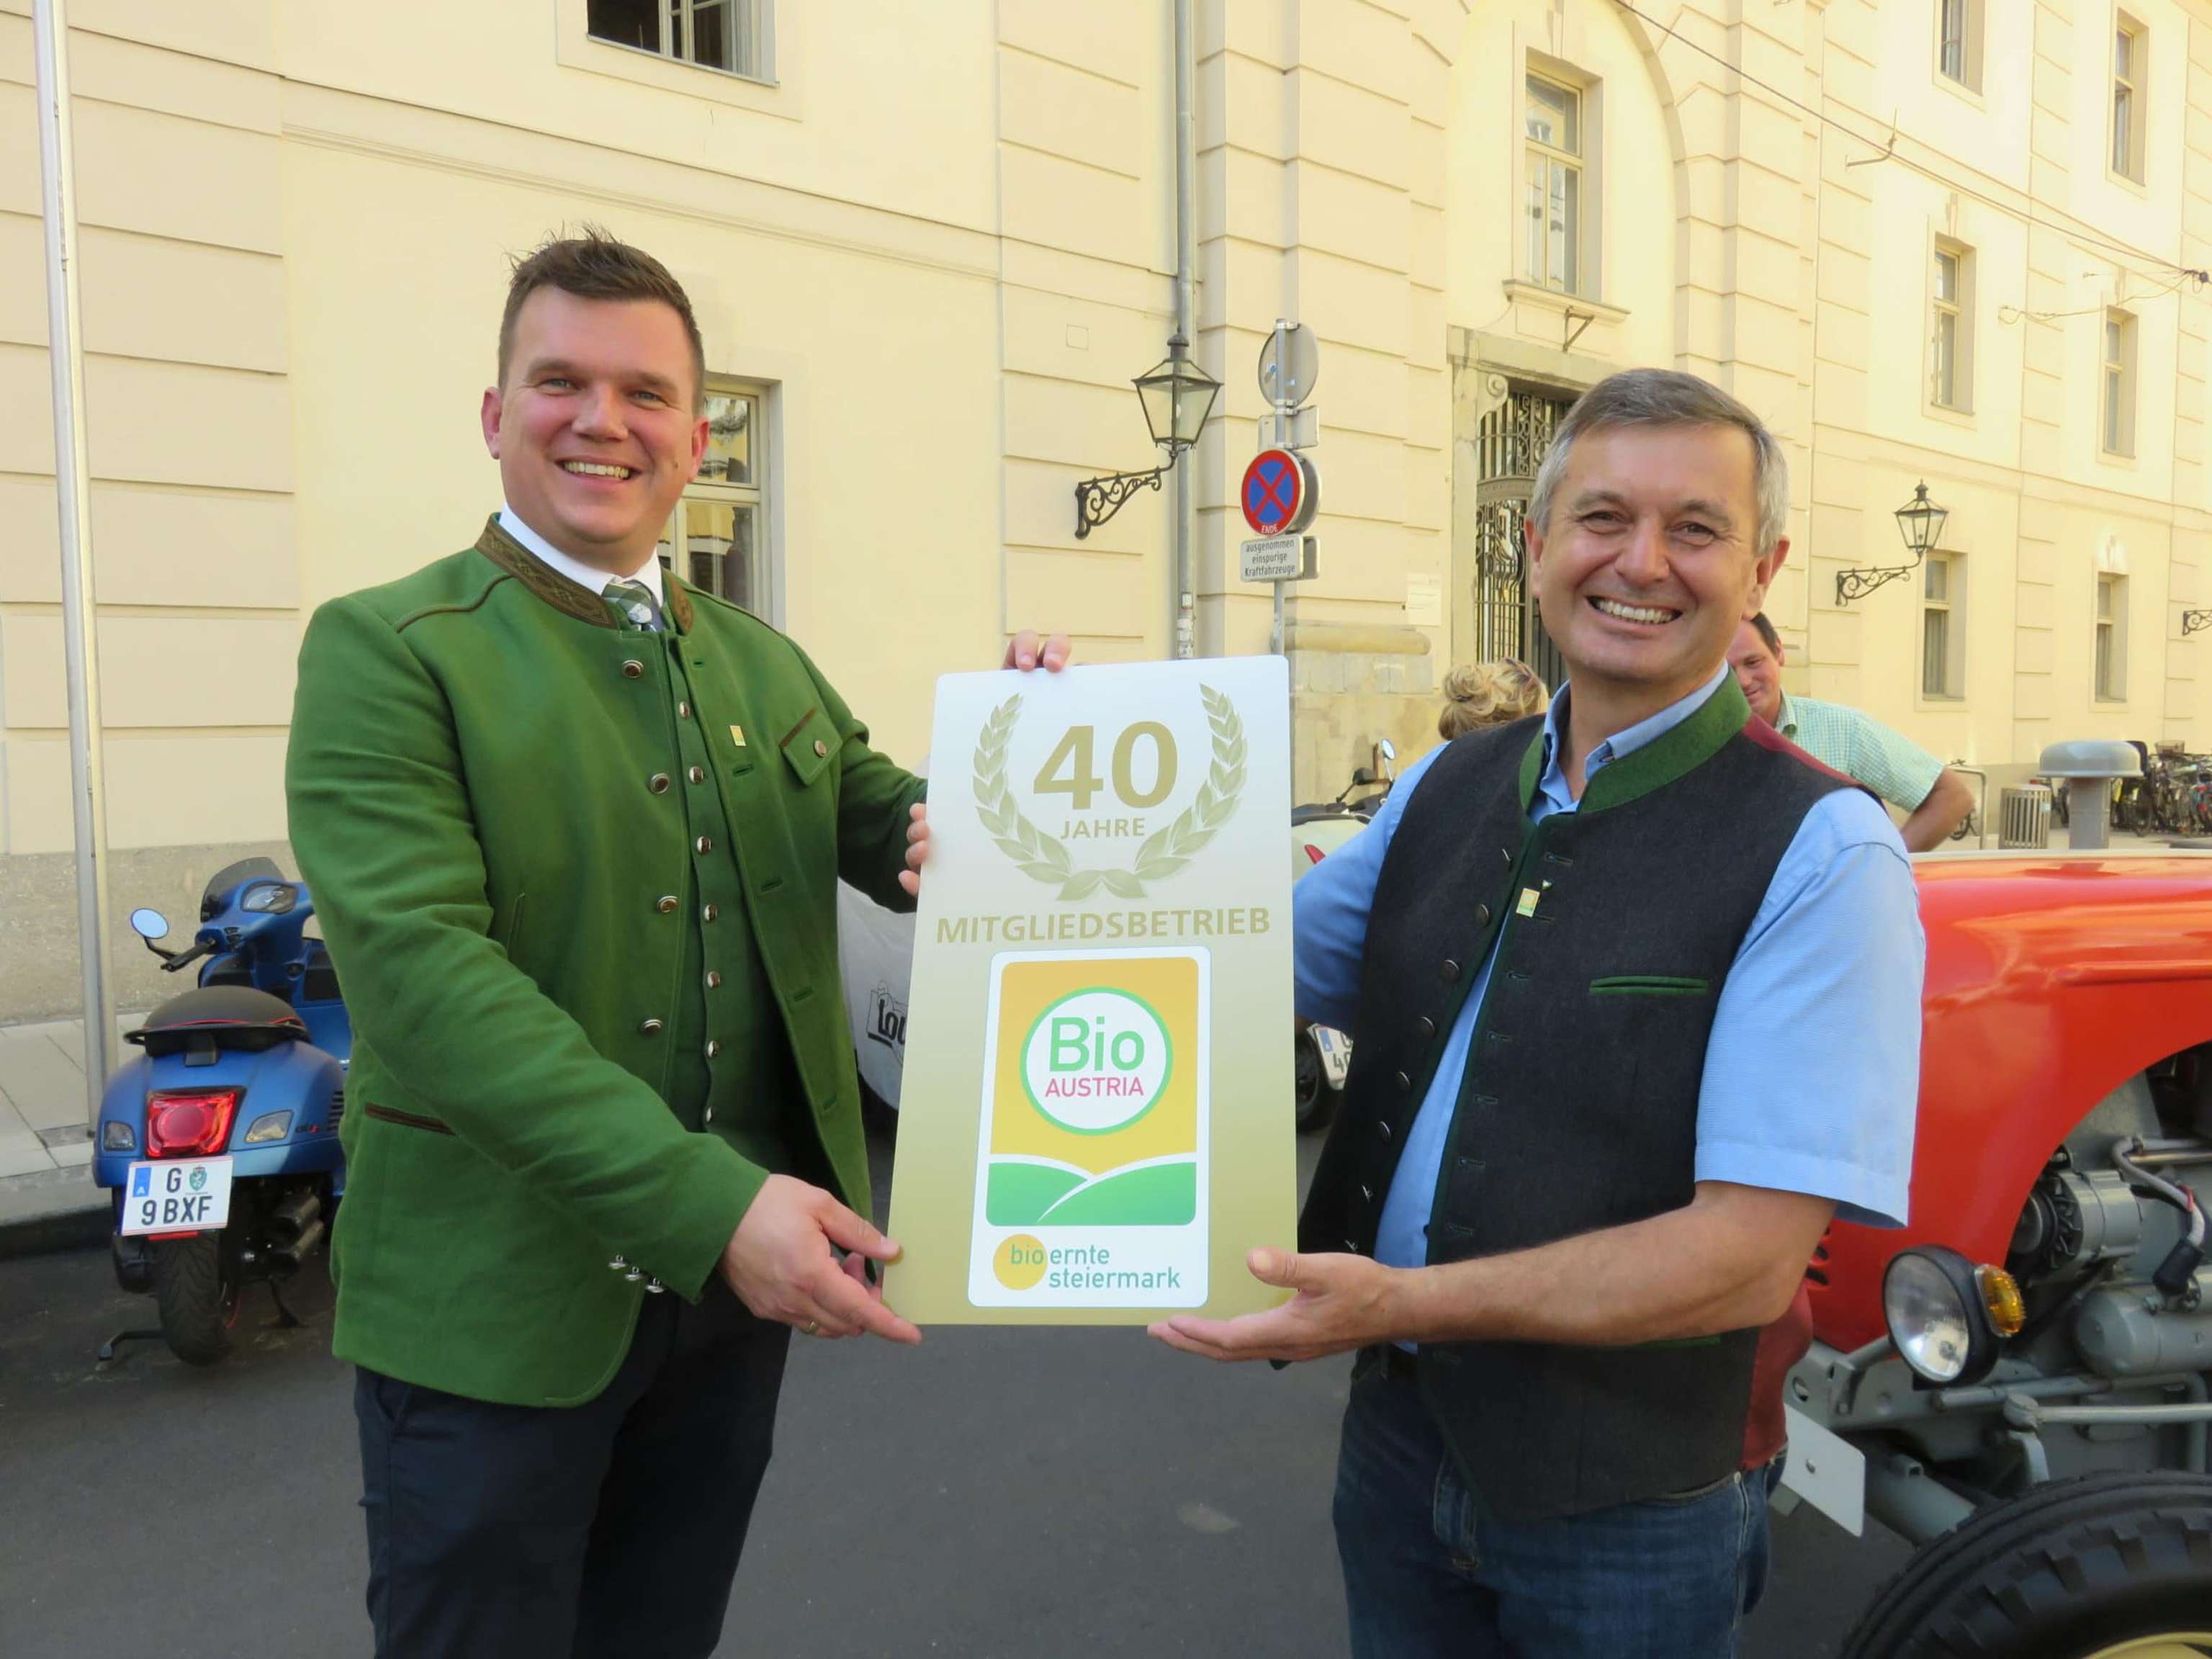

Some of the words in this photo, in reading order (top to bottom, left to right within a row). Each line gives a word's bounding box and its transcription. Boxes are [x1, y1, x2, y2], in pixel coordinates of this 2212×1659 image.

[1261, 523, 1278, 534] ENDE
[1246, 539, 1295, 553] ausgenommen
[1252, 552, 1287, 564] einspurige
[1245, 565, 1295, 577] Kraftfahrzeuge
[1033, 721, 1178, 810] 40
[1060, 817, 1146, 840] JAHRE
[936, 907, 1271, 944] MITGLIEDSBETRIEB
[1049, 1015, 1145, 1072] Bio
[1045, 1077, 1144, 1097] AUSTRIA
[166, 1168, 181, 1192] G
[1048, 1266, 1180, 1288] steiermark
